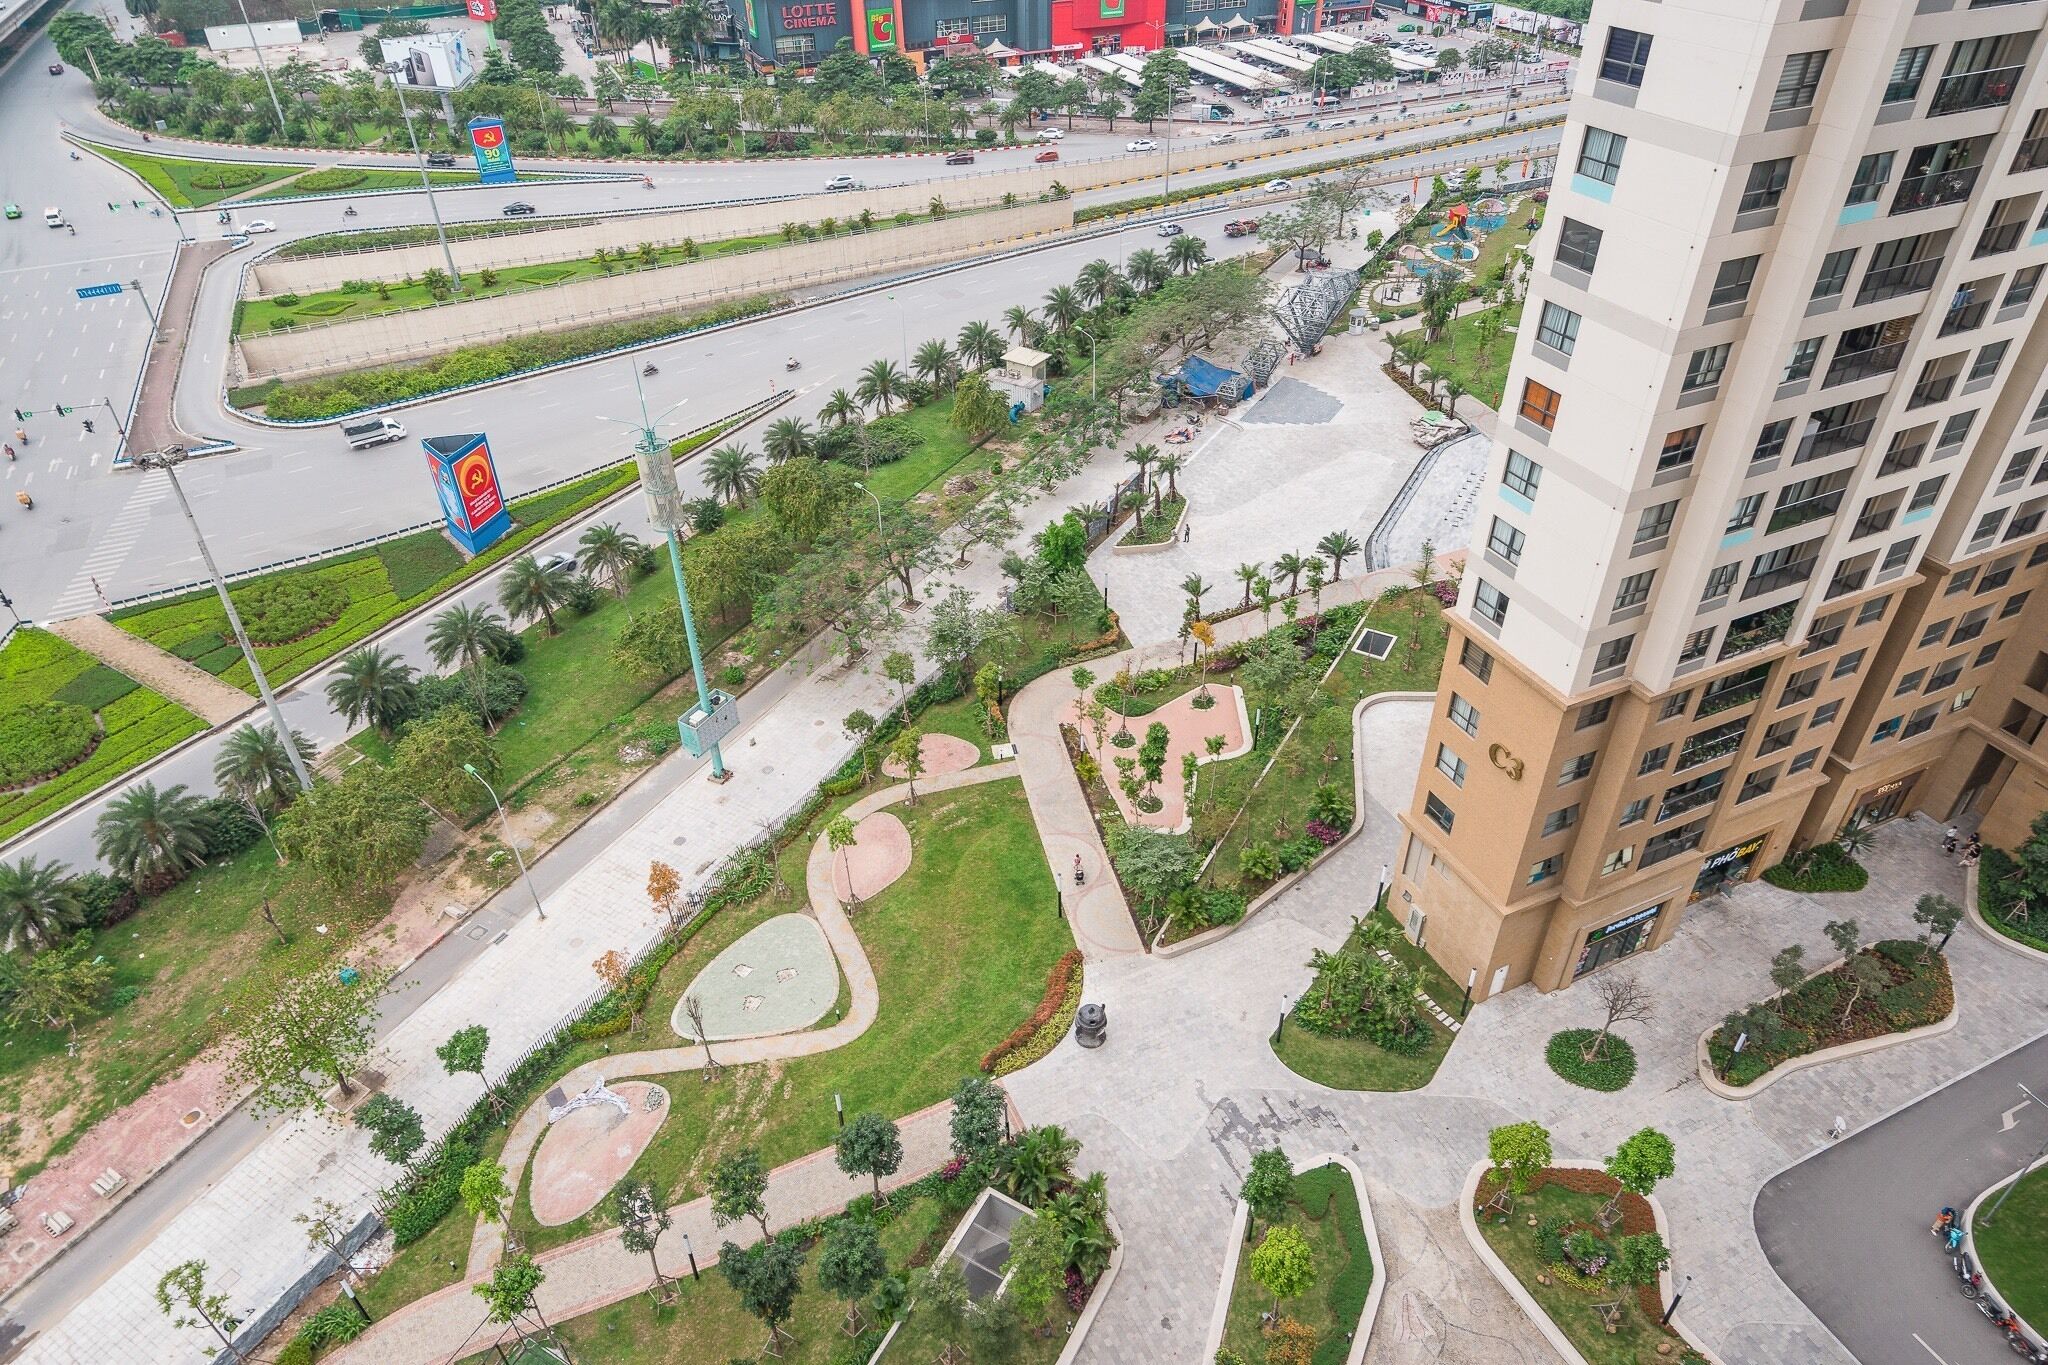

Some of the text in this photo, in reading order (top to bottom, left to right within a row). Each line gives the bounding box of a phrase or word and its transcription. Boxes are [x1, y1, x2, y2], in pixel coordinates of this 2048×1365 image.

[782, 3, 837, 18] LOTTE
[783, 16, 837, 29] CINEMA
[871, 14, 884, 23] Big
[484, 148, 500, 159] 90
